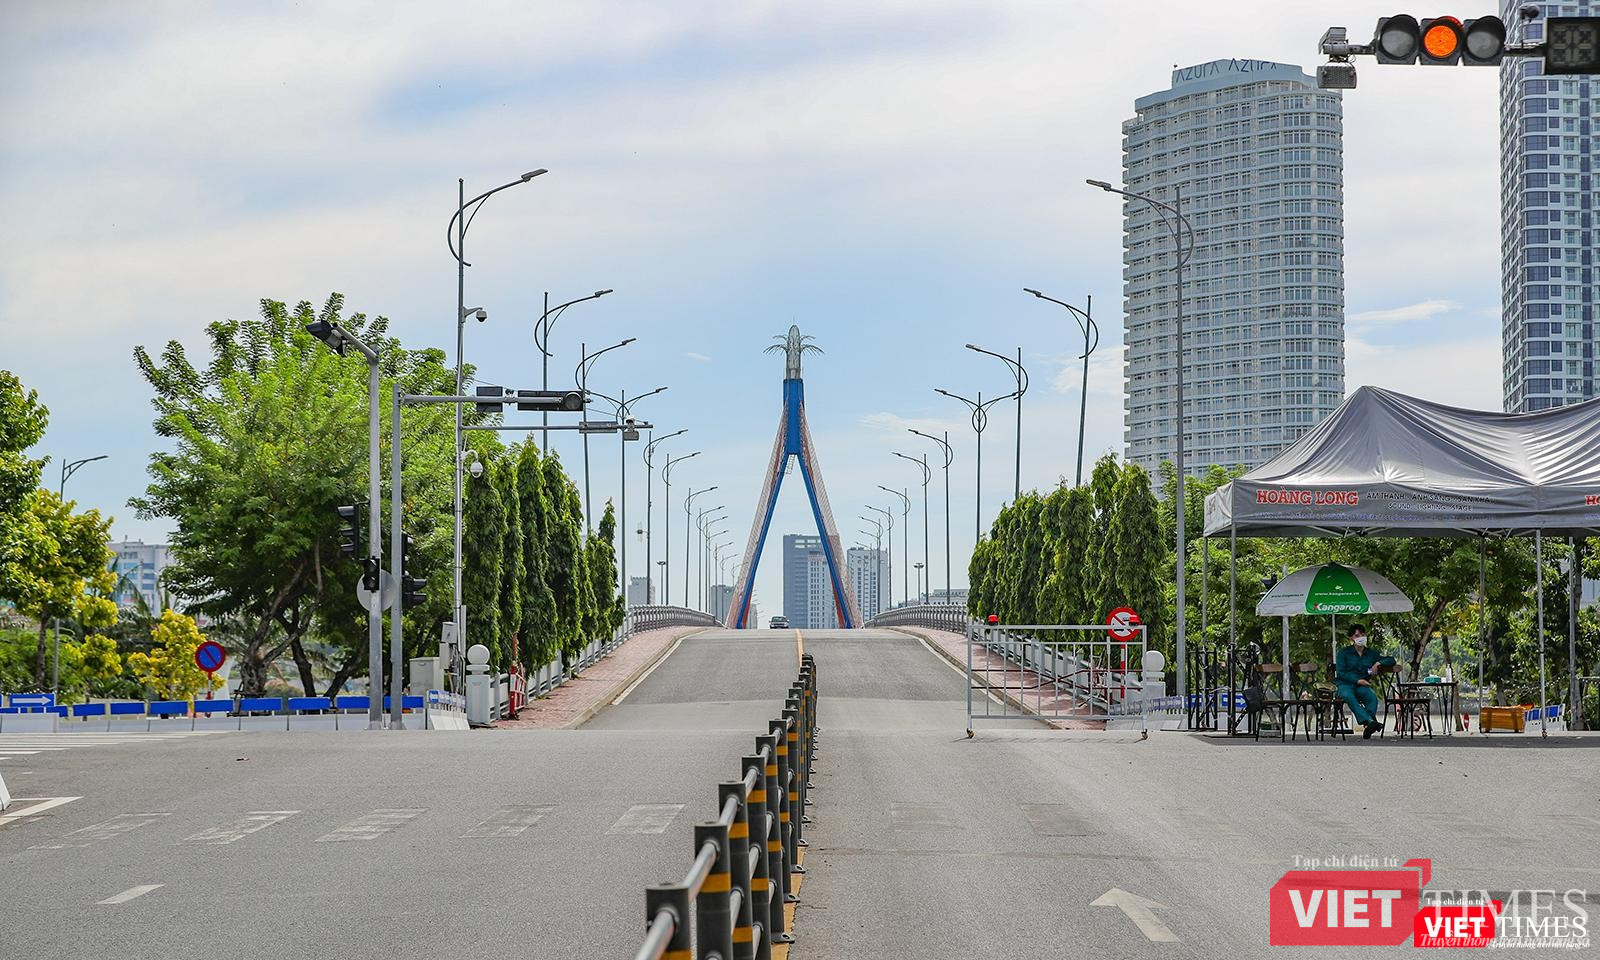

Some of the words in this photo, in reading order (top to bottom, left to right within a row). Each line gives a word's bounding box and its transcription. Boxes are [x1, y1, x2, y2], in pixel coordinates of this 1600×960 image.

[1256, 486, 1312, 505] HOÀNG
[1315, 491, 1359, 506] LONG
[1381, 491, 1405, 500] THANH
[1312, 602, 1361, 613] Kangaroo
